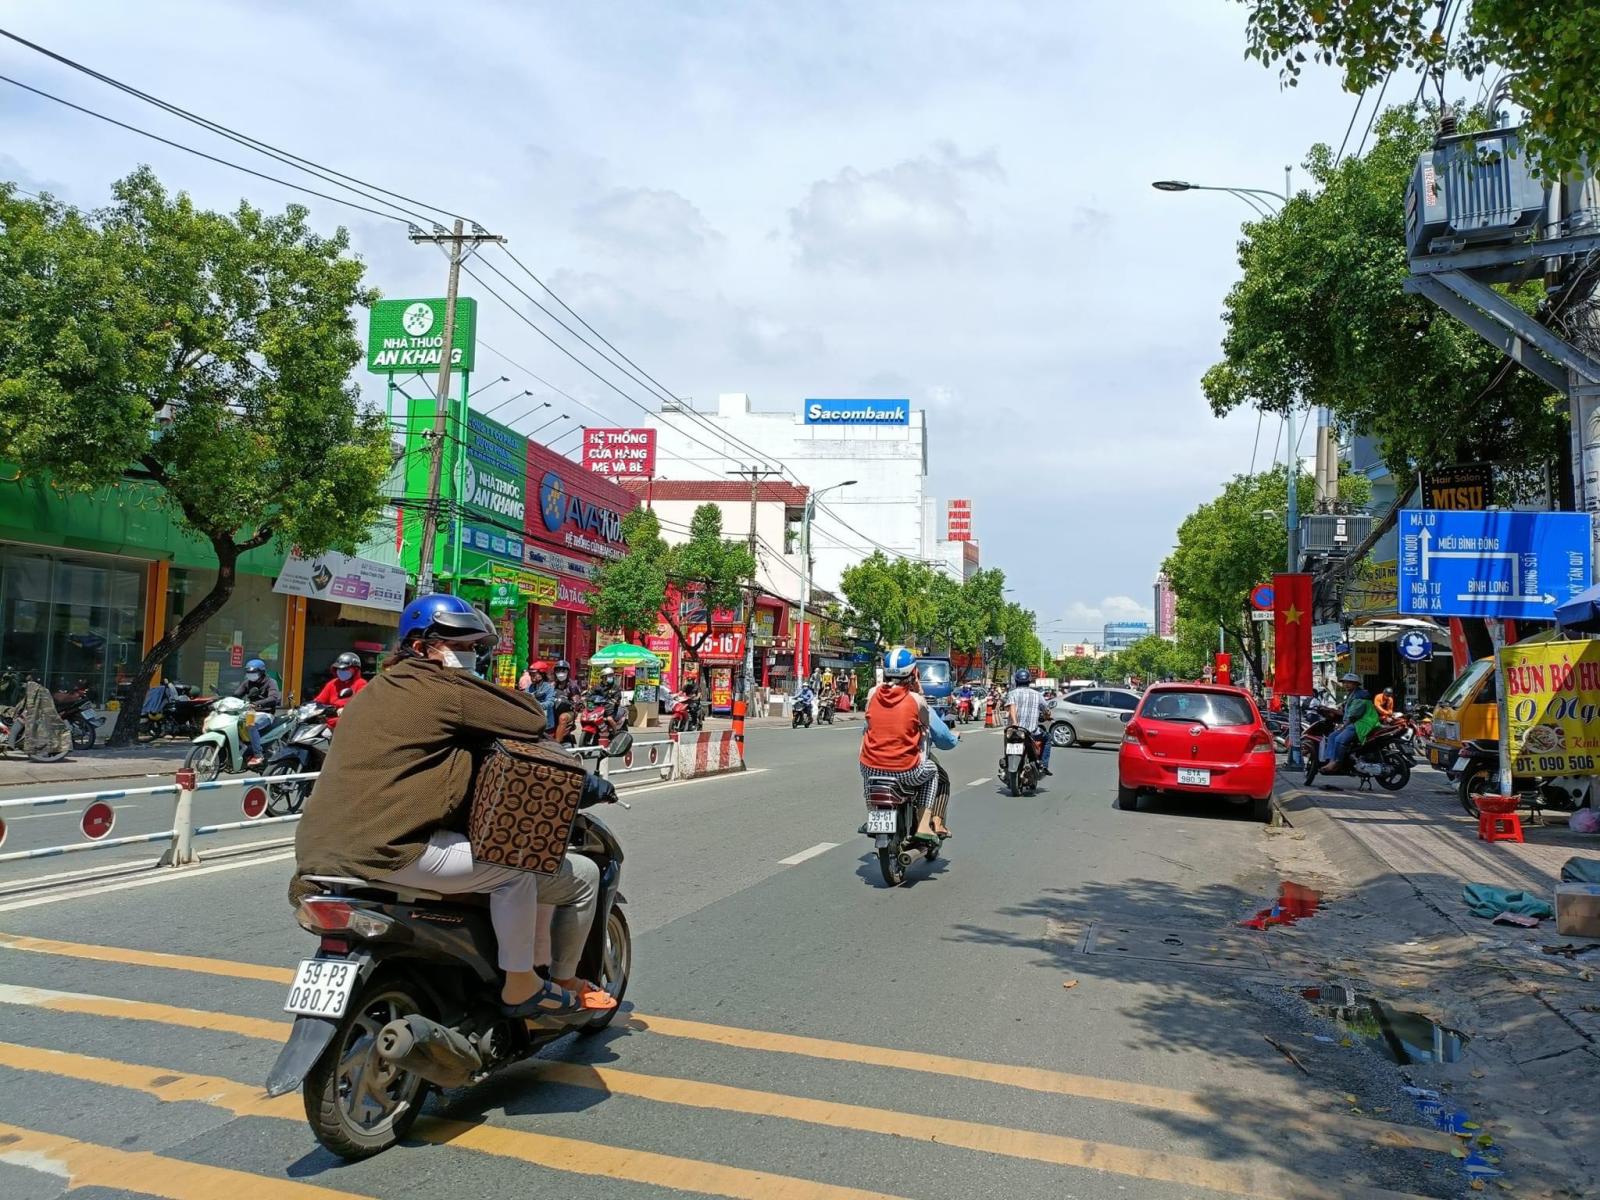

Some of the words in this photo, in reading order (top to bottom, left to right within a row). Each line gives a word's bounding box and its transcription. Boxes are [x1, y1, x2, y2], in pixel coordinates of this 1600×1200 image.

[384, 336, 408, 348] NHÀ
[410, 332, 443, 348] THUỐ
[372, 349, 400, 365] AN
[400, 348, 462, 365] KHAG
[808, 404, 904, 421] Sacombank
[590, 431, 605, 446] HỆ
[606, 429, 648, 443] THỐNG
[615, 446, 648, 459] HÀNG
[592, 462, 609, 474] MẸ
[611, 459, 627, 472] VÀ
[480, 471, 495, 490] NHÀ
[495, 479, 520, 499] THUỐC
[1455, 473, 1481, 483] Salon
[472, 487, 490, 508] AN
[490, 492, 525, 520] KHANG
[1432, 486, 1483, 510] MISU
[1410, 512, 1425, 526] MÃ
[1438, 534, 1457, 549] MIẾU
[1458, 535, 1477, 550] BÌNH
[1478, 537, 1499, 550] ĐÔNG
[1411, 580, 1427, 593] NGÃ
[1430, 581, 1442, 594] TƯ
[1467, 577, 1486, 592] BÌNH
[1488, 580, 1510, 593] LONG
[1412, 594, 1428, 609] BỐN
[1431, 595, 1442, 609] XÃ
[1507, 656, 1545, 696] BÚN
[1549, 654, 1576, 693] BÒ
[1546, 696, 1600, 725] Ng
[1517, 757, 1535, 772] ĐT:
[1539, 756, 1565, 771] 090
[1568, 755, 1594, 770] 506
[303, 963, 348, 988] 59-P3
[289, 986, 345, 1013] 080.73
